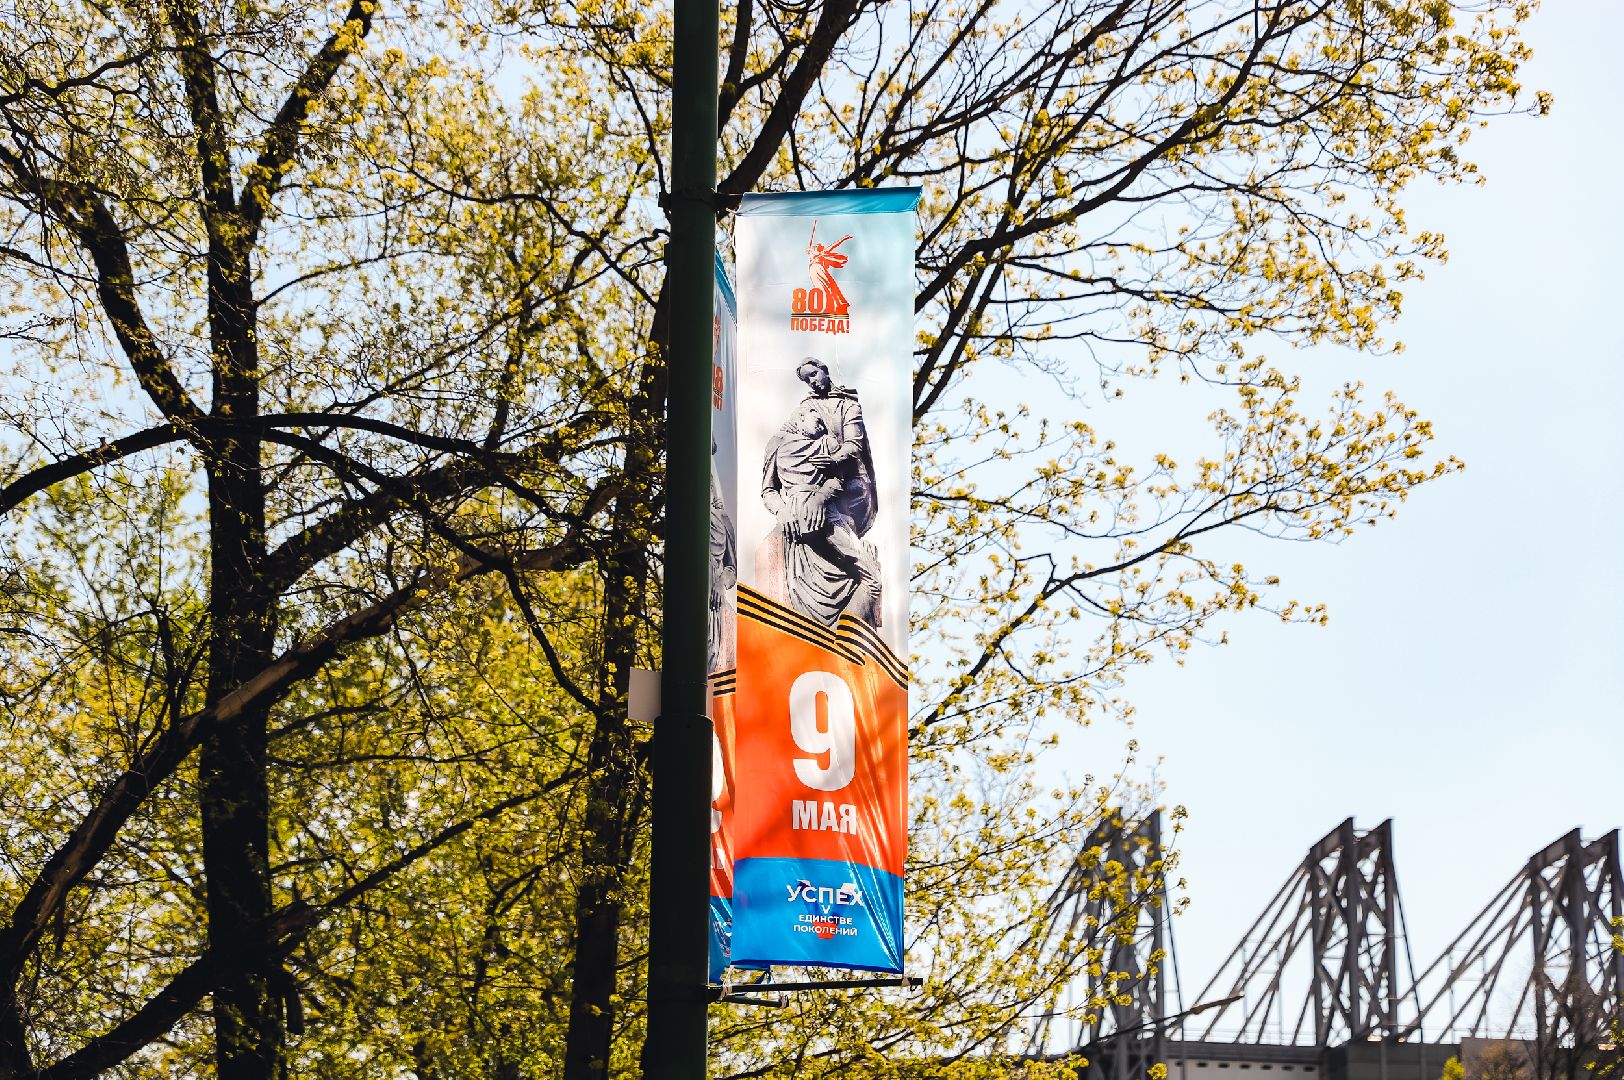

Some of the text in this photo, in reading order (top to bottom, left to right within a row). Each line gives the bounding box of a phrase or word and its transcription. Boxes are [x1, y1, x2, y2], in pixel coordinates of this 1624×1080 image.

[791, 287, 824, 314] 80
[790, 317, 850, 335] ПОБЕДА!
[789, 670, 856, 792] 9
[792, 799, 857, 835] МАЯ
[786, 883, 865, 907] УСПЕХ
[793, 924, 858, 936] ПОКОЛЕНИЙ
[798, 914, 853, 925] ЕДИНСТВЕ
